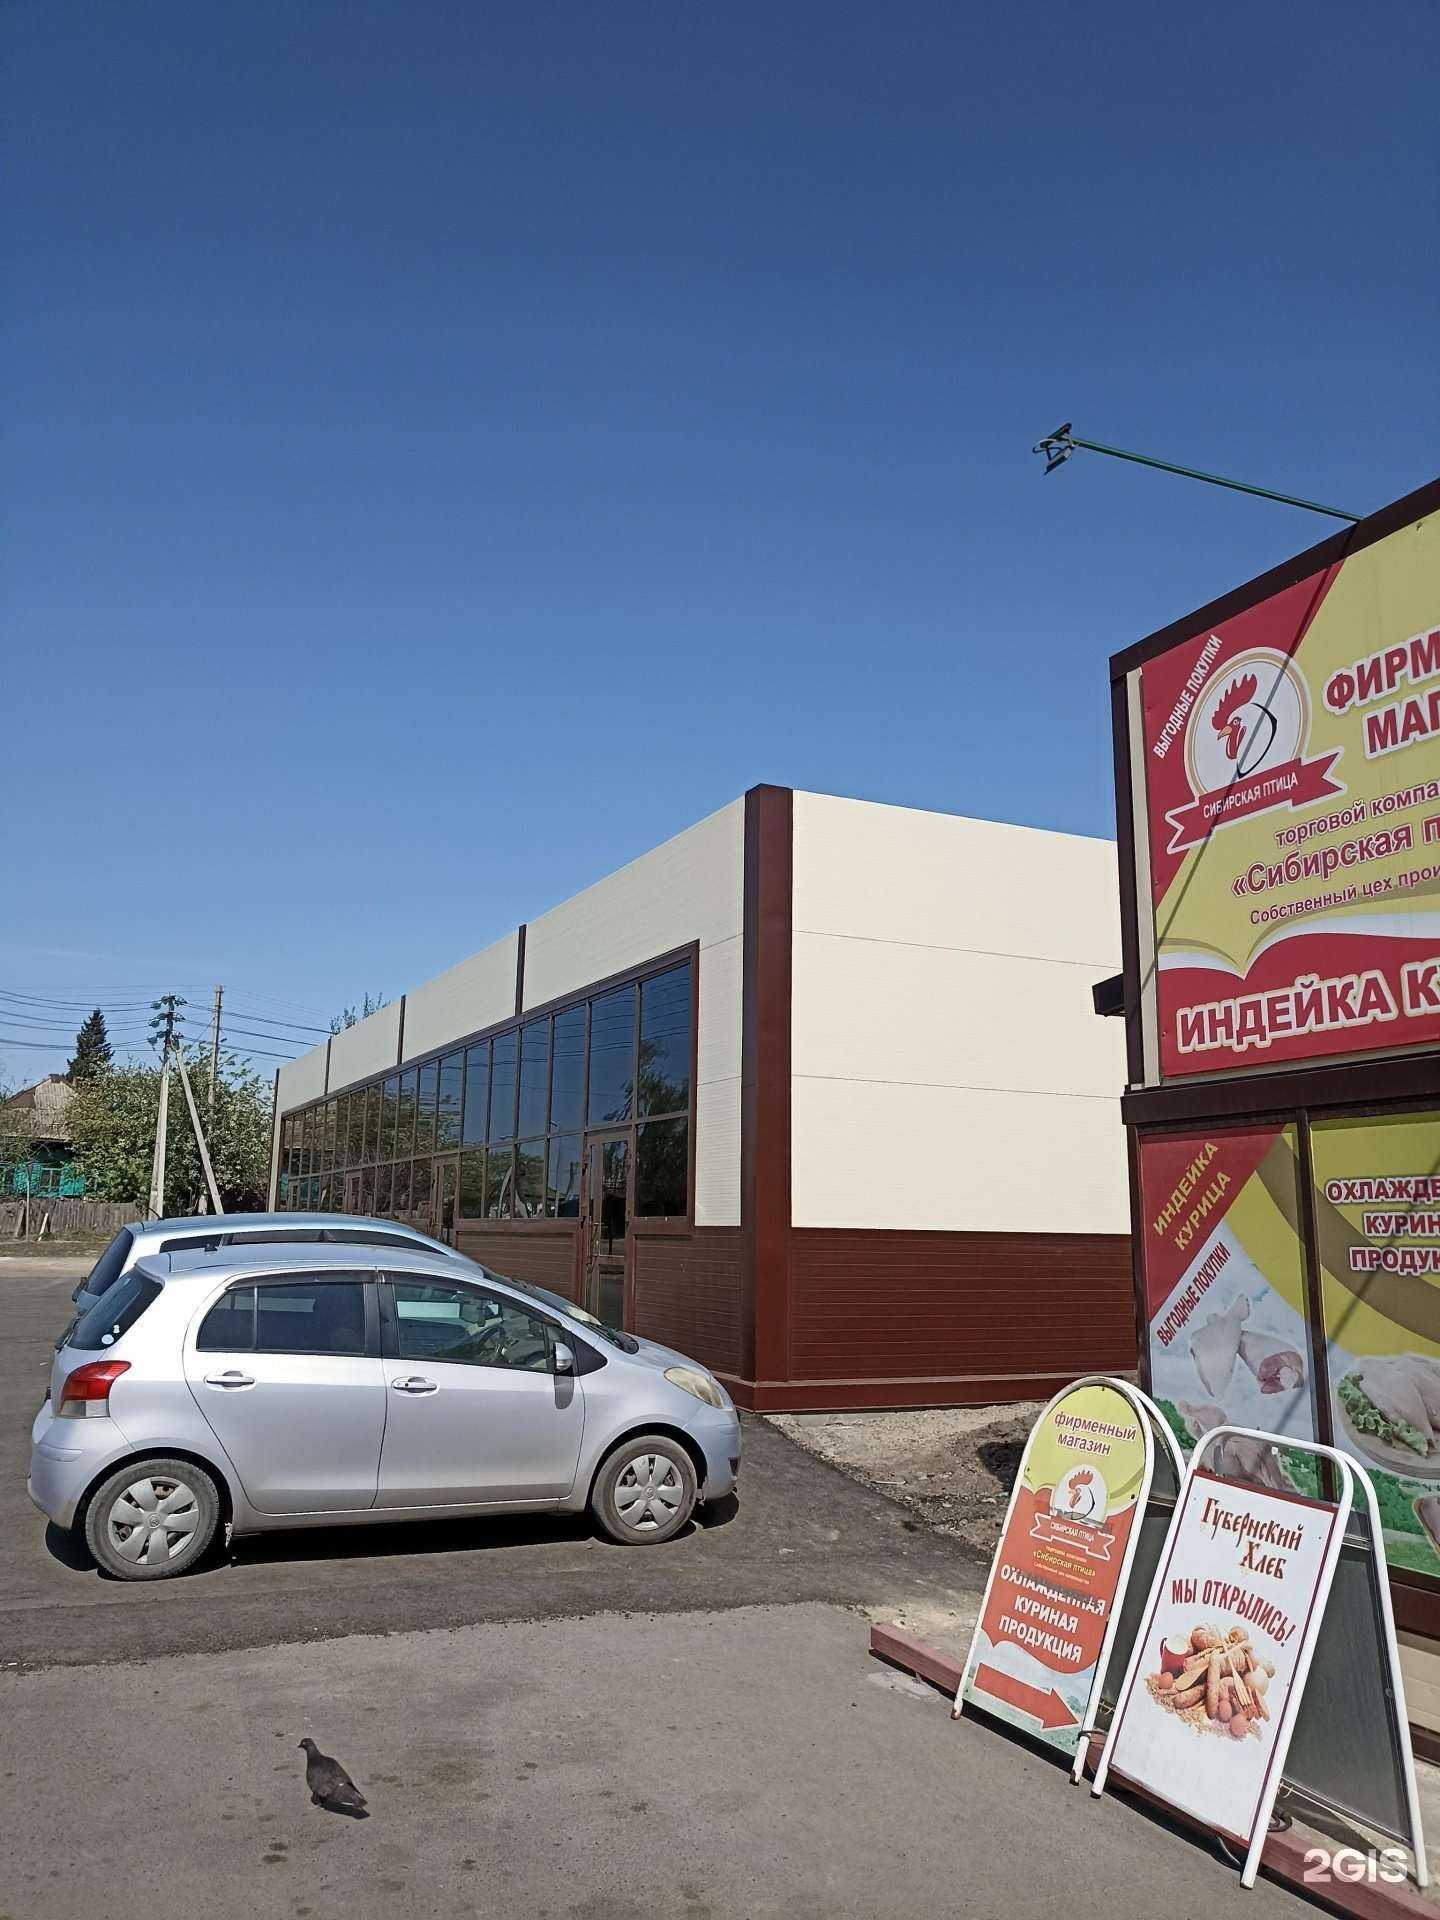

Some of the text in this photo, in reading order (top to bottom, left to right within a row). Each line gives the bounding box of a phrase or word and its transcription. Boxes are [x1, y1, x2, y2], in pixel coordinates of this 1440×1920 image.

[1153, 634, 1223, 759] ВЫГОДНЫЕ ПОКУПКИ
[1325, 629, 1440, 711] ФИРМ
[1203, 772, 1299, 819] СИБИРСКАЯ ПТИЦА
[1275, 781, 1440, 847] торговой компа
[1231, 824, 1413, 897] «Сибирская
[1250, 885, 1358, 925] Собственный
[1362, 876, 1393, 897] цех
[1178, 974, 1394, 1048] ИНДЕЙКА
[1153, 1141, 1219, 1237] ИНДЕЙКА
[1174, 1171, 1232, 1250] КУРИЦА
[1326, 1178, 1440, 1203] ОХЛАЖДЕ
[1364, 1213, 1440, 1235] КУРИН
[1156, 1241, 1232, 1347] ВЫГОДНЫЕ ПОКУПКИ
[1054, 1411, 1137, 1440] фирменный
[1057, 1433, 1111, 1455] магазин
[1240, 1541, 1288, 1580] Хлеб
[999, 1614, 1083, 1664] ПРОДУКЦИЯ
[1014, 1594, 1079, 1633] КУРИНАЯ
[1170, 1577, 1296, 1648] МЫ ОТКРЫЛИСЬ!
